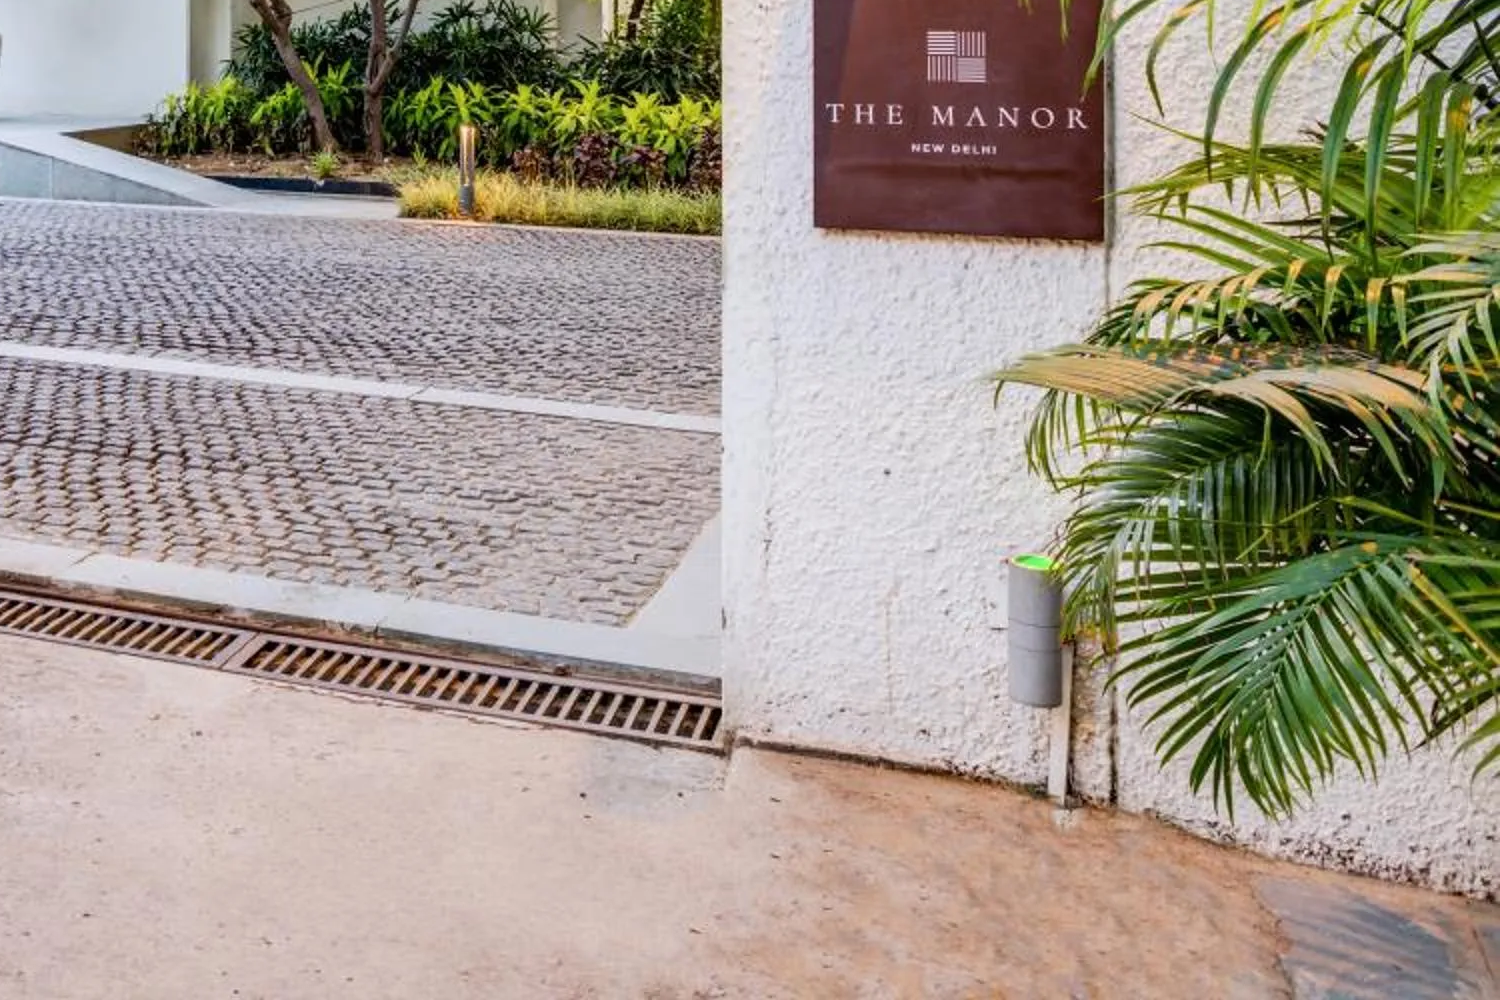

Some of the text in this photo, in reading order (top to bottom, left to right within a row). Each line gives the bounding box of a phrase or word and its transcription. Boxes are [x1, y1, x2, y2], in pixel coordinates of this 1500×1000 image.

[825, 103, 1089, 130] THE MANOR
[911, 142, 997, 155] NEW DELHI
